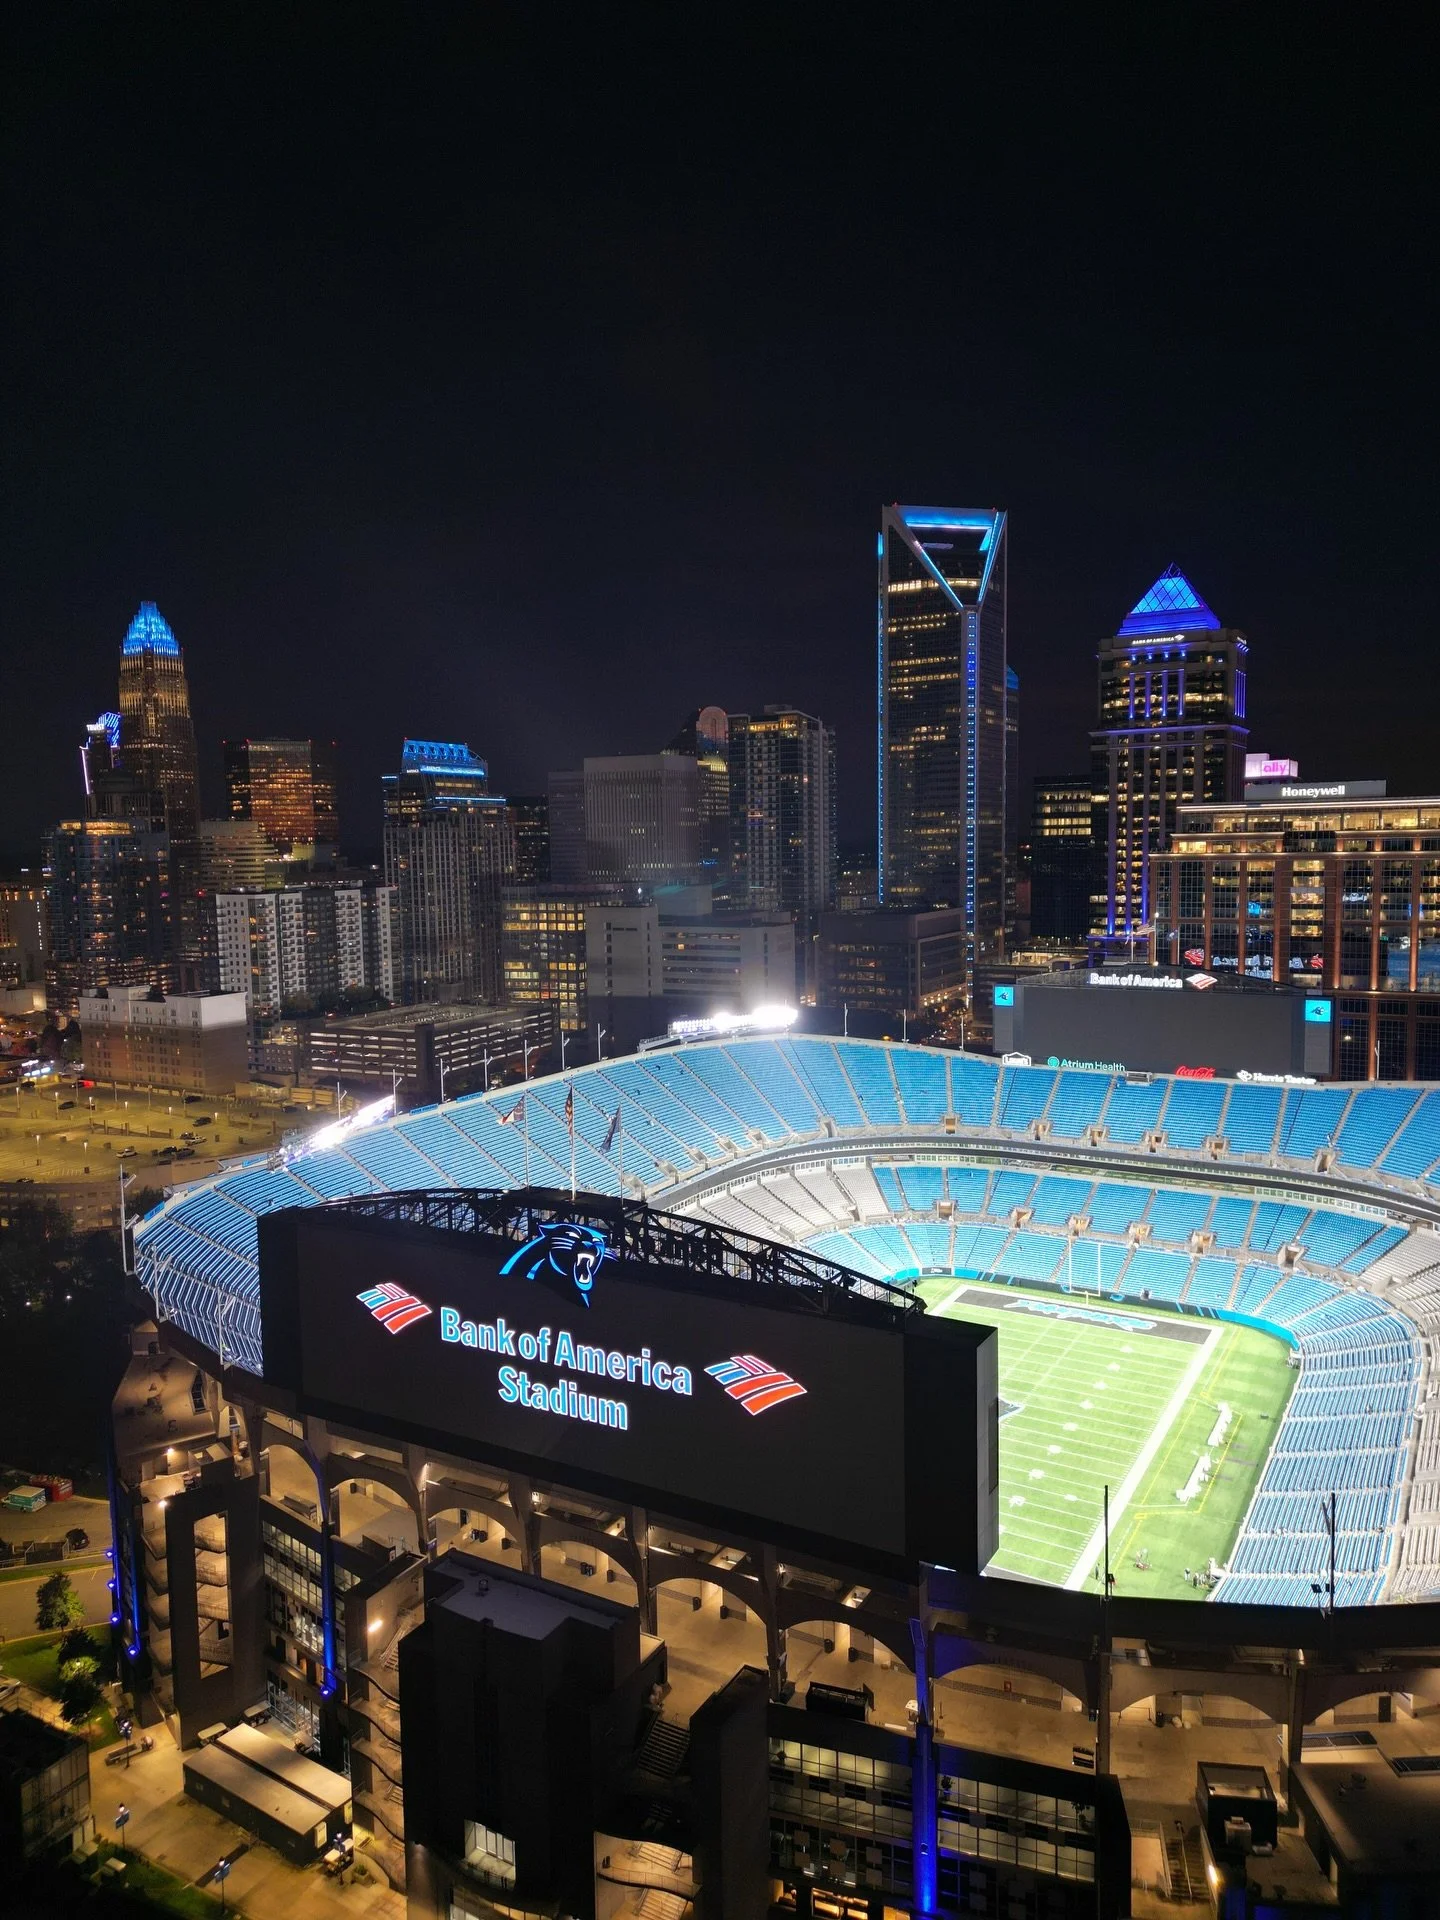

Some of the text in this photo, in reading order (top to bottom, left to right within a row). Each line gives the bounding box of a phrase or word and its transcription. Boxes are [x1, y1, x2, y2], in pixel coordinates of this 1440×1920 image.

[1263, 761, 1287, 775] ally
[1281, 785, 1345, 798] Honeywell
[1090, 972, 1183, 989] Bank of America
[1060, 1059, 1126, 1072] Atrium Health
[1253, 1072, 1317, 1085] Harris Teeter
[440, 1306, 692, 1396] Bank of America
[497, 1365, 628, 1431] Stadium
